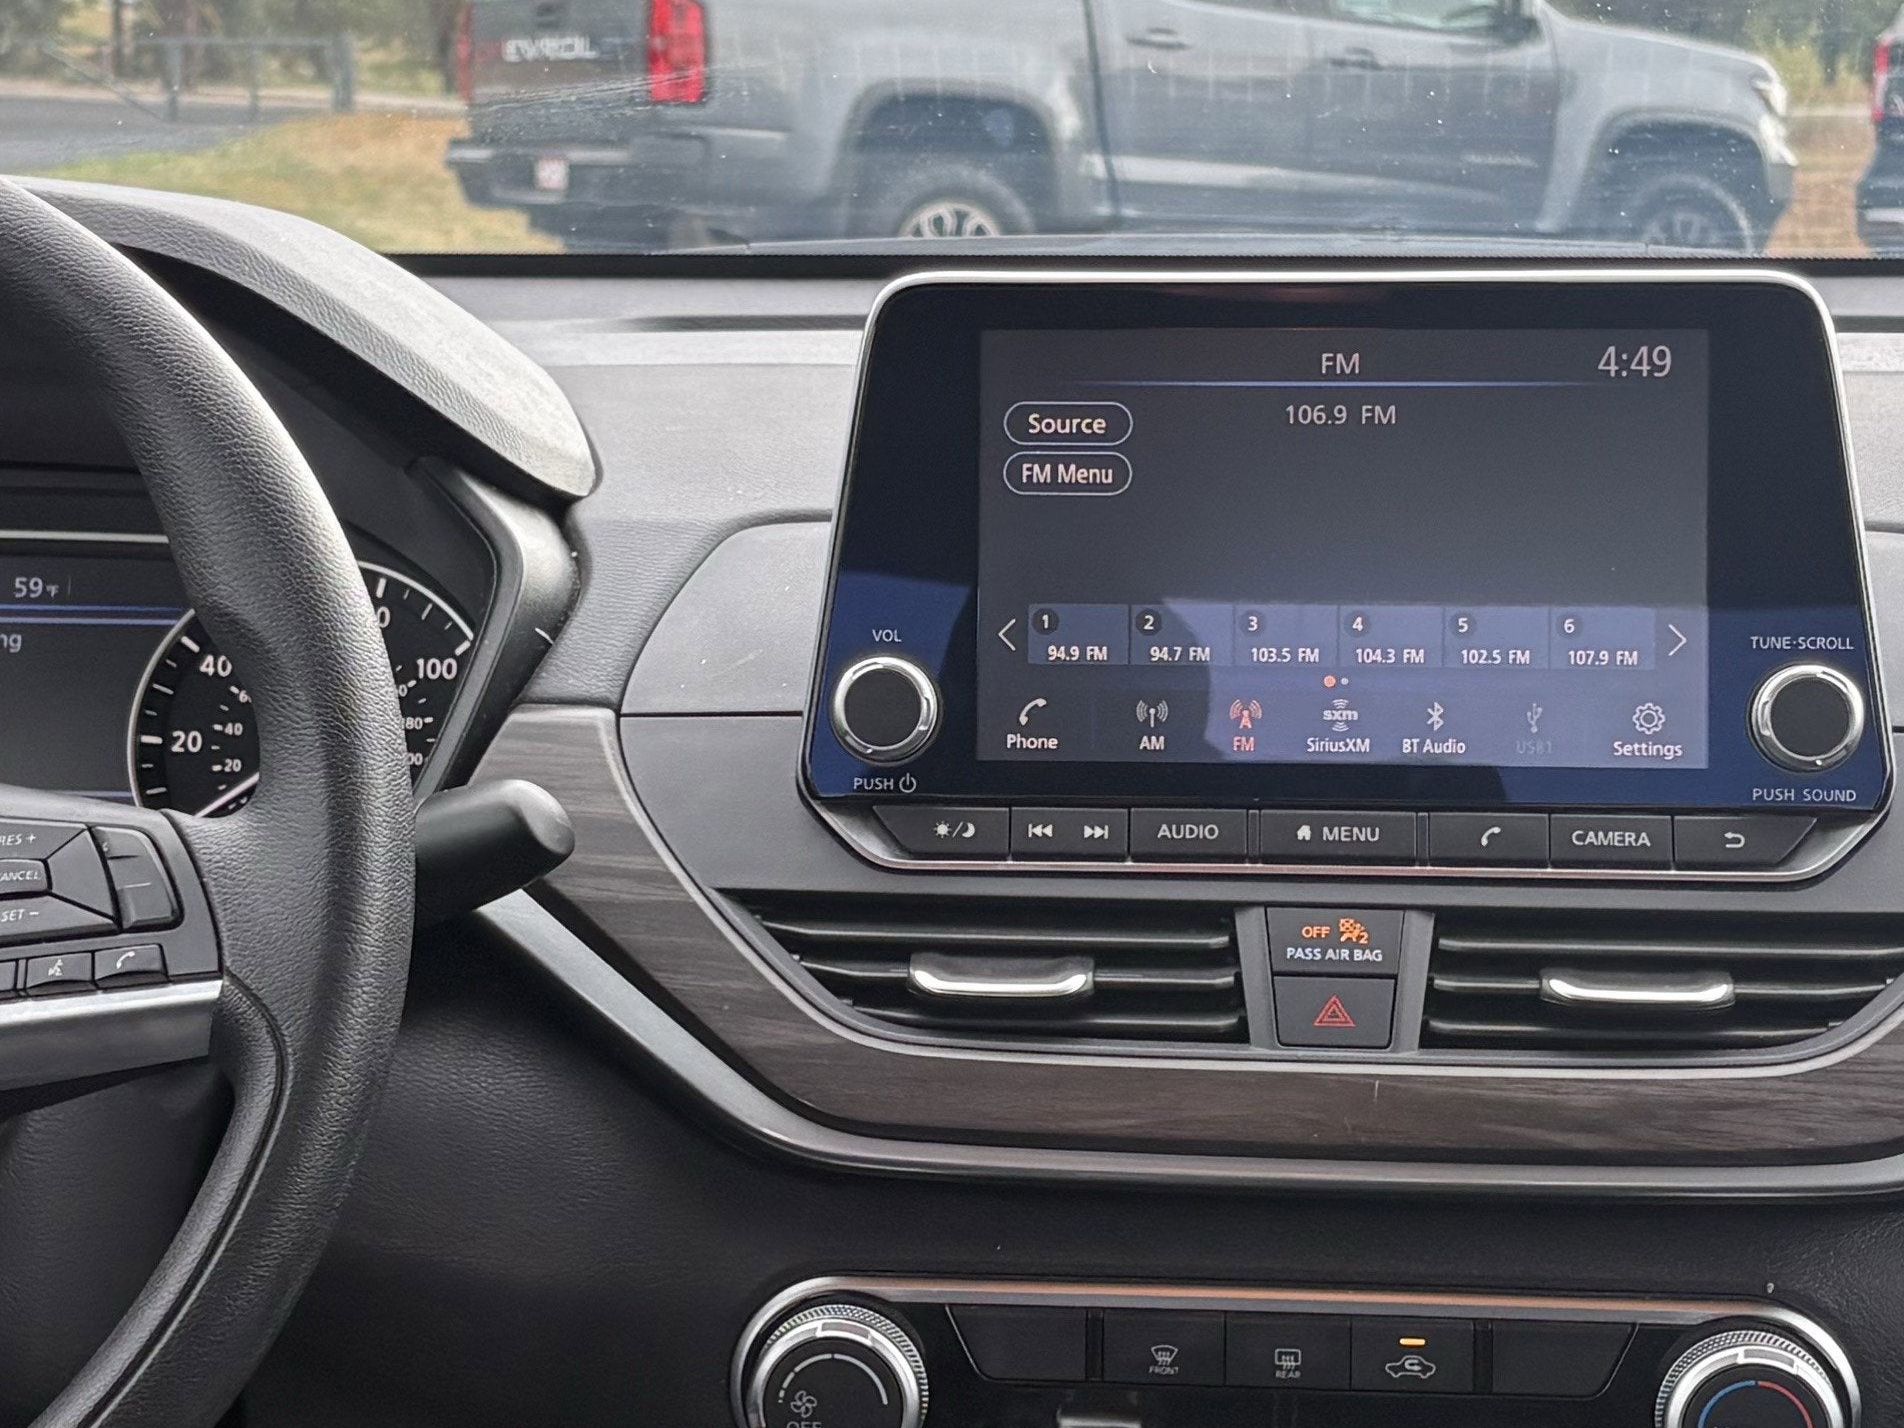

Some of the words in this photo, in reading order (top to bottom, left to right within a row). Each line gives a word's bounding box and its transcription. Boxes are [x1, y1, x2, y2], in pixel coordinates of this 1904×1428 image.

[1321, 353, 1361, 374] FM
[1597, 345, 1672, 378] 4:49
[1285, 404, 1348, 425] 106.9
[1361, 404, 1396, 425] FM
[1028, 413, 1107, 434] Source
[1021, 463, 1051, 484] FM
[1057, 463, 1113, 484] Menu
[376, 606, 391, 629] 0
[1041, 614, 1050, 629] 1
[1143, 615, 1155, 630] 2
[1248, 616, 1258, 631] 3
[1352, 617, 1364, 632] 4
[1457, 618, 1469, 633] 5
[1563, 619, 1575, 634] 6
[872, 629, 902, 643] VOL
[1047, 645, 1080, 662] 94.9
[1086, 646, 1108, 662] FM
[1150, 646, 1181, 662] 94.7
[1188, 647, 1211, 662] FM
[1251, 647, 1291, 663] 103.5
[1297, 647, 1320, 663] FM
[1355, 648, 1396, 664] 104.3
[1403, 649, 1425, 664] FM
[1461, 649, 1502, 665] 102.5
[1508, 650, 1531, 665] FM
[1568, 650, 1610, 666] 107.9
[1616, 651, 1638, 666] FM
[199, 655, 232, 677] 40
[416, 658, 458, 680] 100
[1323, 709, 1358, 722] sxm
[224, 722, 243, 736] 40
[171, 731, 202, 753] 20
[1006, 733, 1059, 750] Phone
[1139, 735, 1165, 751] AM
[1233, 736, 1255, 752] FM
[1306, 736, 1371, 754] SiriusXM
[1402, 739, 1421, 754] BT
[1423, 738, 1466, 754] Audio
[1613, 740, 1683, 760] Settings
[224, 759, 242, 772] 20
[407, 753, 423, 766] 00
[853, 776, 894, 791] PUSH
[1752, 788, 1795, 802] PUSH
[1803, 789, 1857, 803] SOUND
[1157, 823, 1219, 840] AUDIO
[1322, 825, 1381, 842] MENU
[1571, 831, 1651, 848] CAMERA
[0, 907, 26, 922] SET
[1302, 926, 1330, 938] OFF
[1286, 947, 1322, 960] PASS
[1325, 948, 1349, 960] AIR
[1354, 949, 1383, 962] BAG
[1148, 1365, 1179, 1376] FRONT
